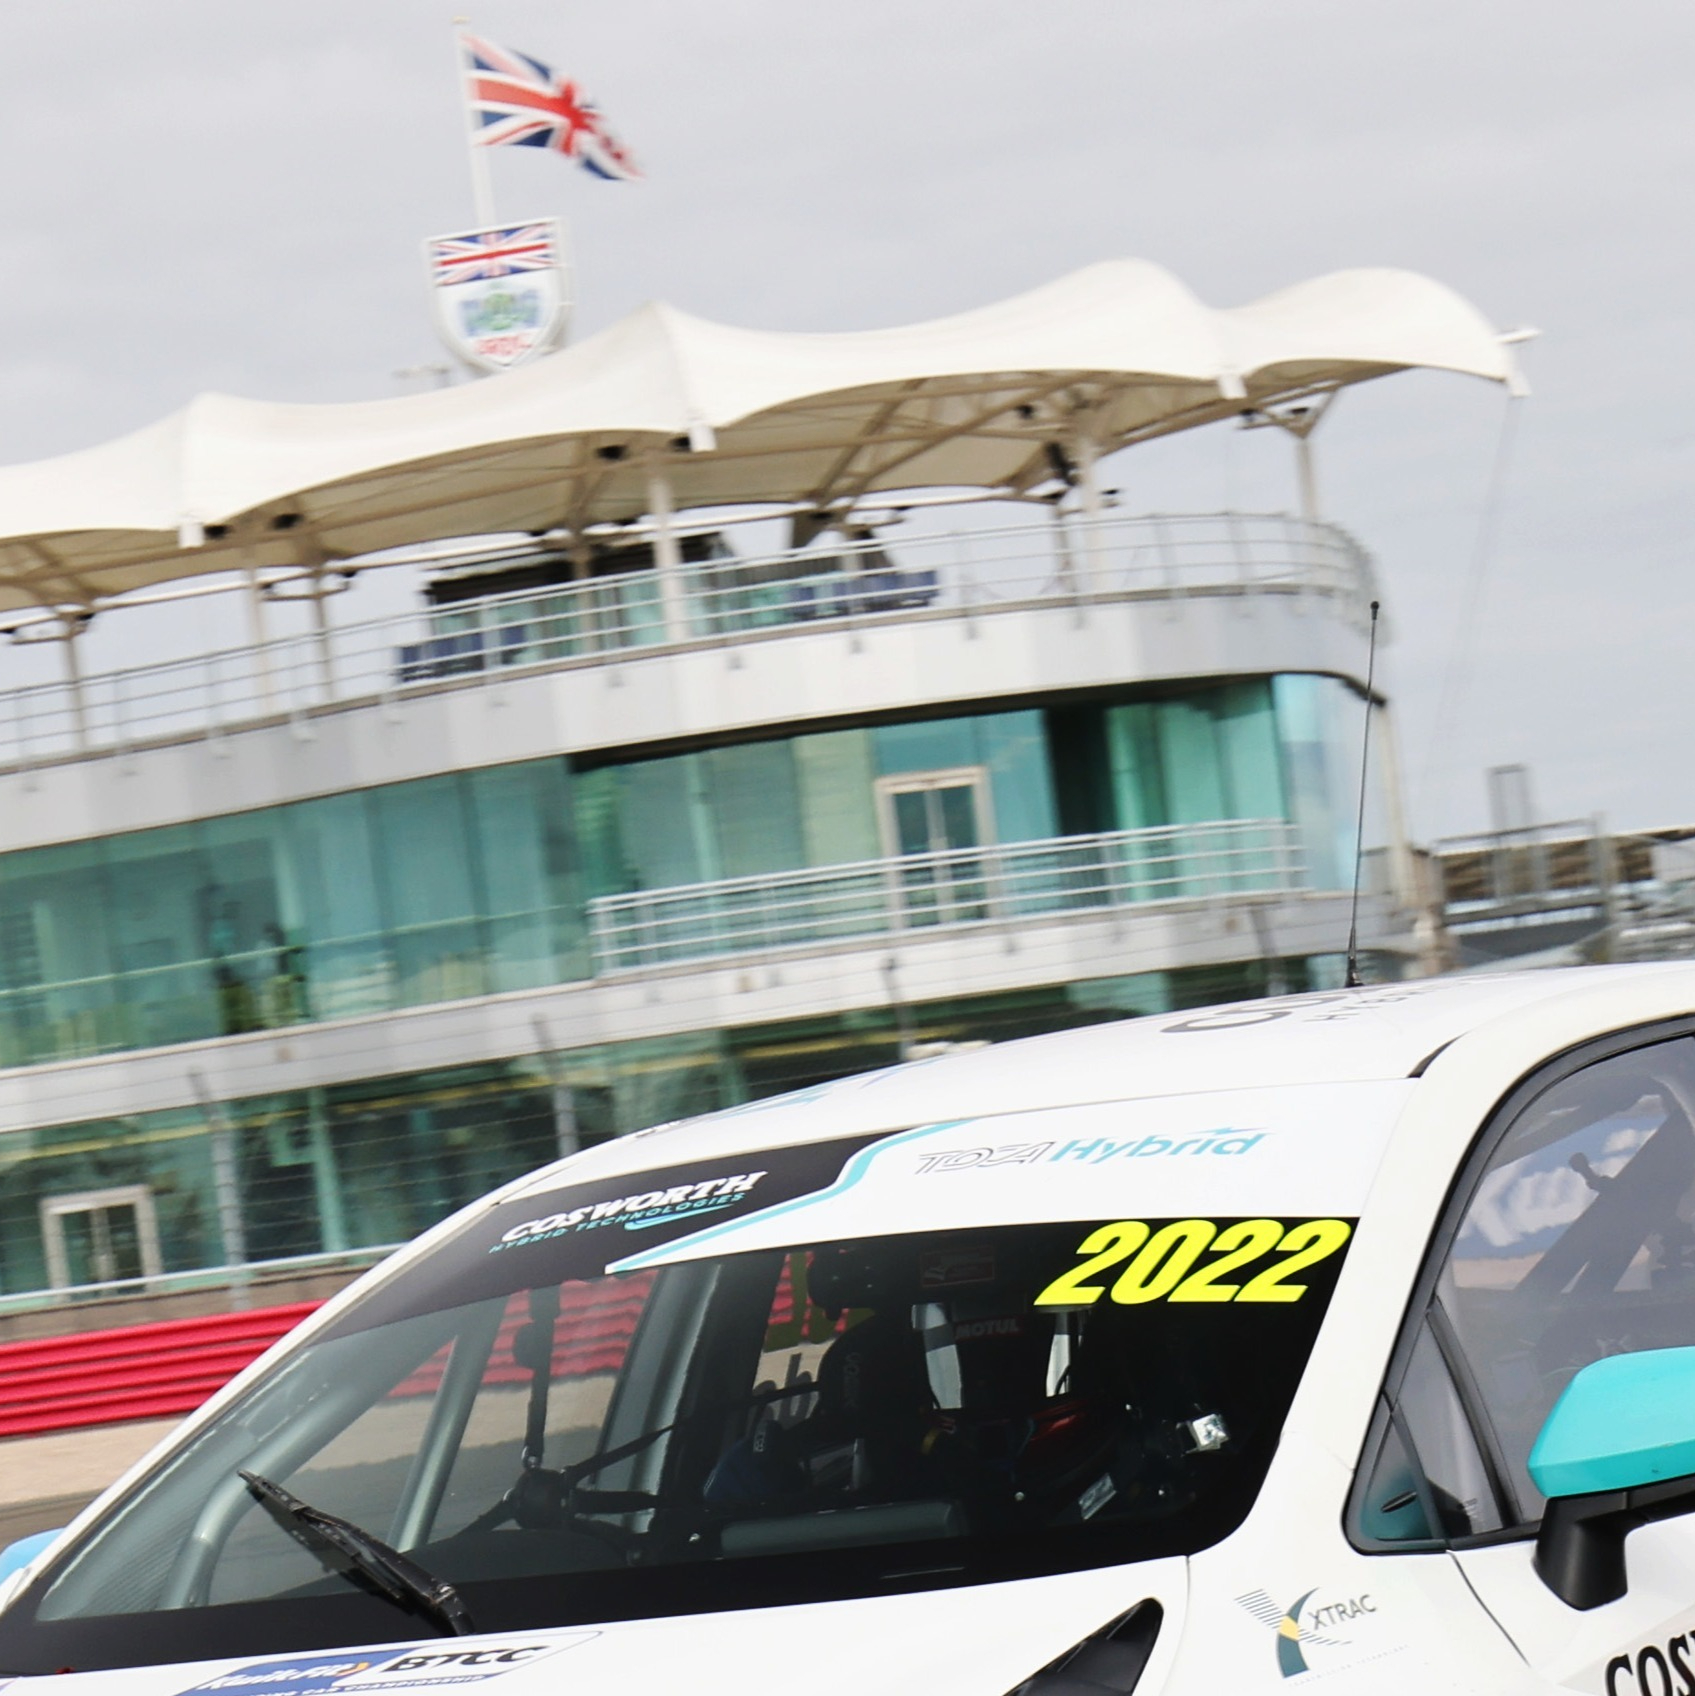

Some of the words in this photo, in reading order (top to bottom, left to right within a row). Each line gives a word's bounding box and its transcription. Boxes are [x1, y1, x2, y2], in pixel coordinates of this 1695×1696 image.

[488, 1227, 569, 1254] HYBRID
[575, 1192, 747, 1233] TECHNOLOGIES
[501, 1171, 769, 1242] COSWORTH
[1033, 1218, 1352, 1306] 2022
[955, 1318, 1021, 1338] MOTUL
[1307, 1594, 1377, 1631] XTRAC
[381, 1645, 551, 1673] BTCC
